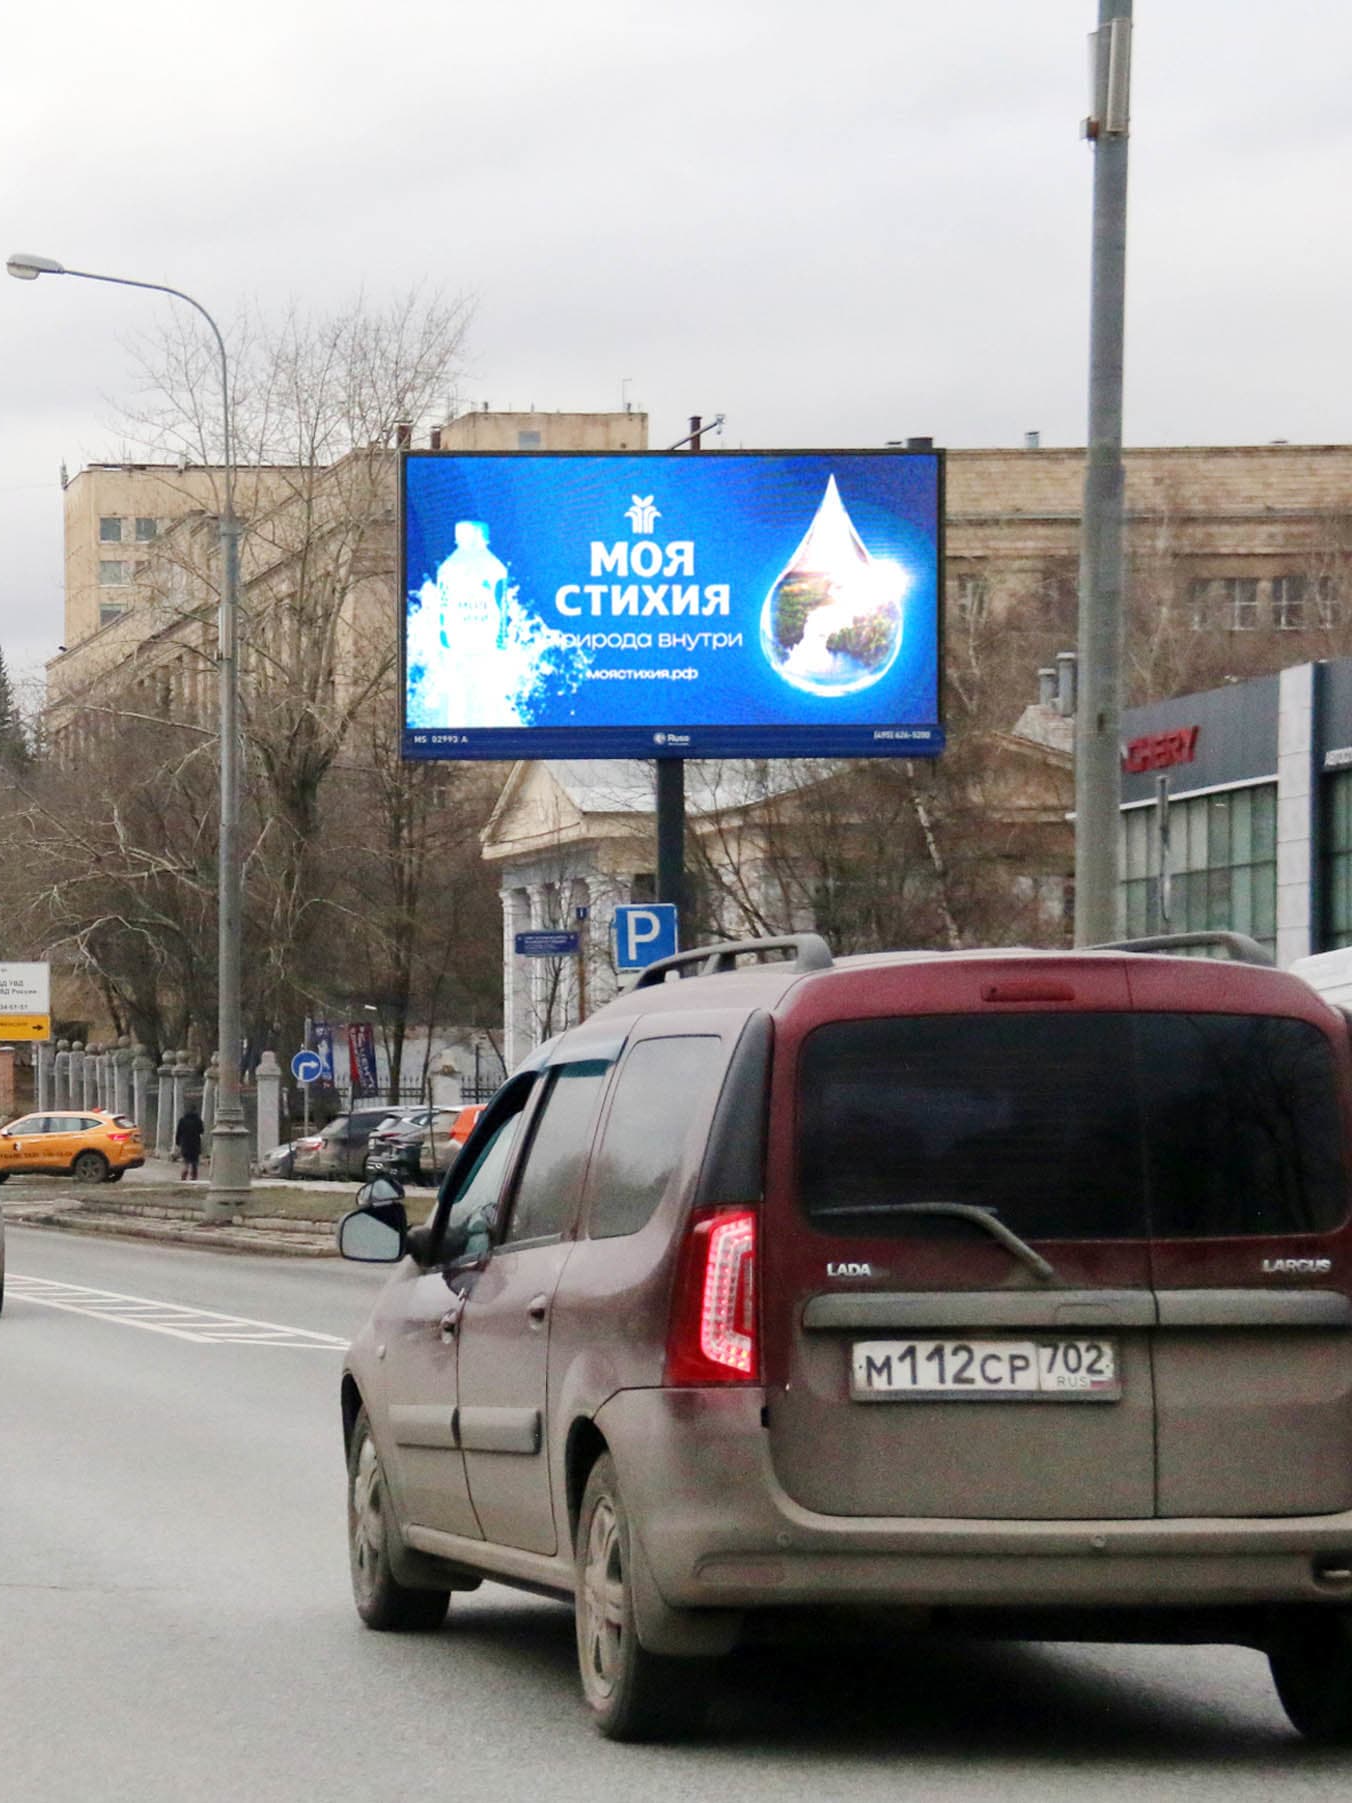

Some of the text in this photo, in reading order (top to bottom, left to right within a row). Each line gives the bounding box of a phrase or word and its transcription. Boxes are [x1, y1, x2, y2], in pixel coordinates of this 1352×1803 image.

[590, 541, 695, 578] МОЯ
[555, 584, 730, 616] СТИХИЯ
[658, 632, 743, 651] внутри
[586, 668, 698, 681] моястихия.рф
[1123, 726, 1200, 773] CHERY
[826, 1263, 871, 1277] LADA
[1263, 1258, 1331, 1274] LARGUS
[1046, 1343, 1104, 1375] 702
[1057, 1375, 1089, 1388] RUS
